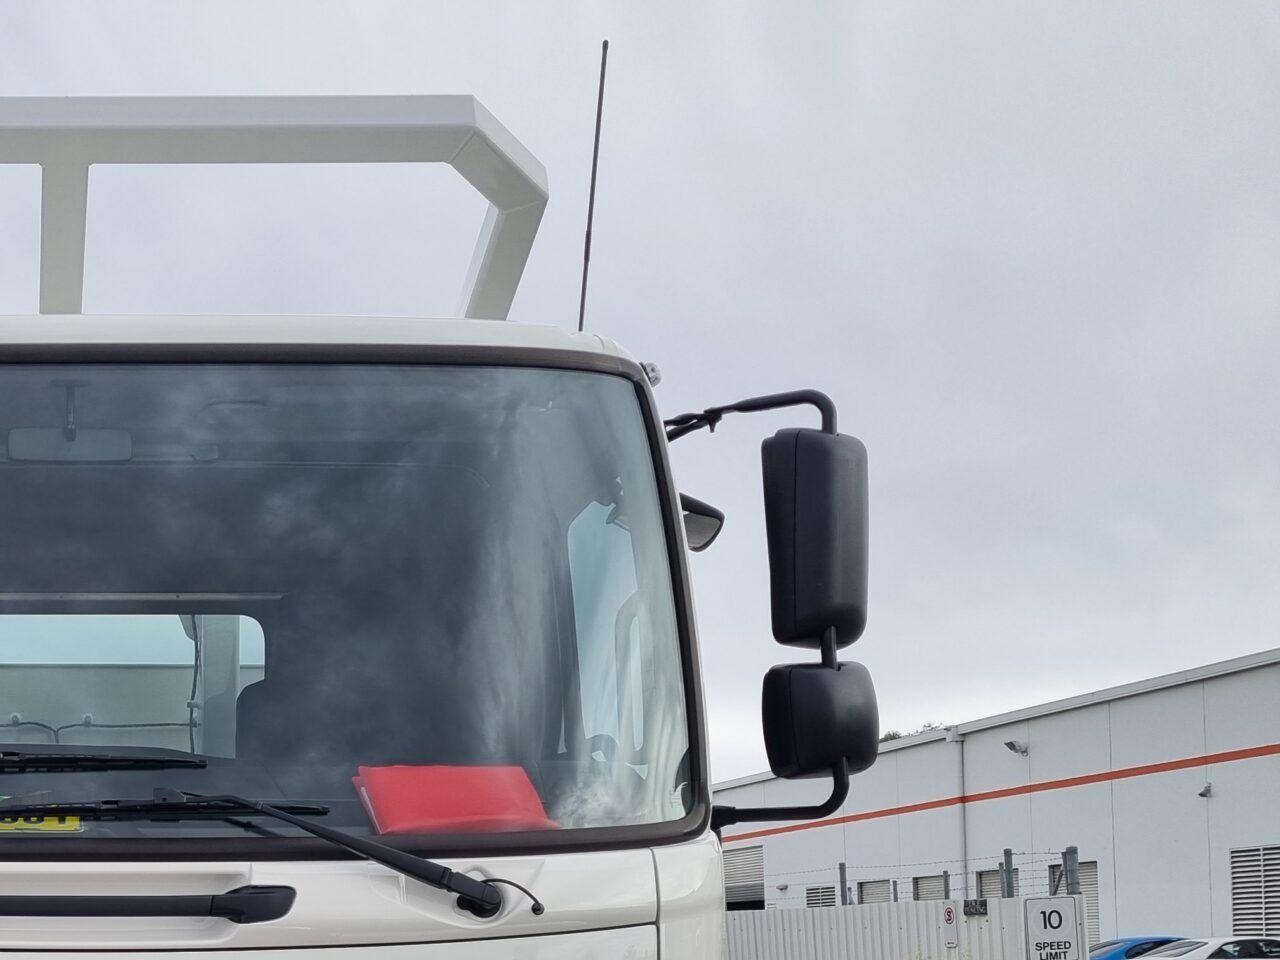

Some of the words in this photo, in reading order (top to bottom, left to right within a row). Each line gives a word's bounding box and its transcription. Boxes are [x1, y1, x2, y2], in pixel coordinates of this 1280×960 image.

[1040, 909, 1063, 930] 10
[1035, 941, 1072, 951] SPEED
[1040, 951, 1069, 960] LIMIT
